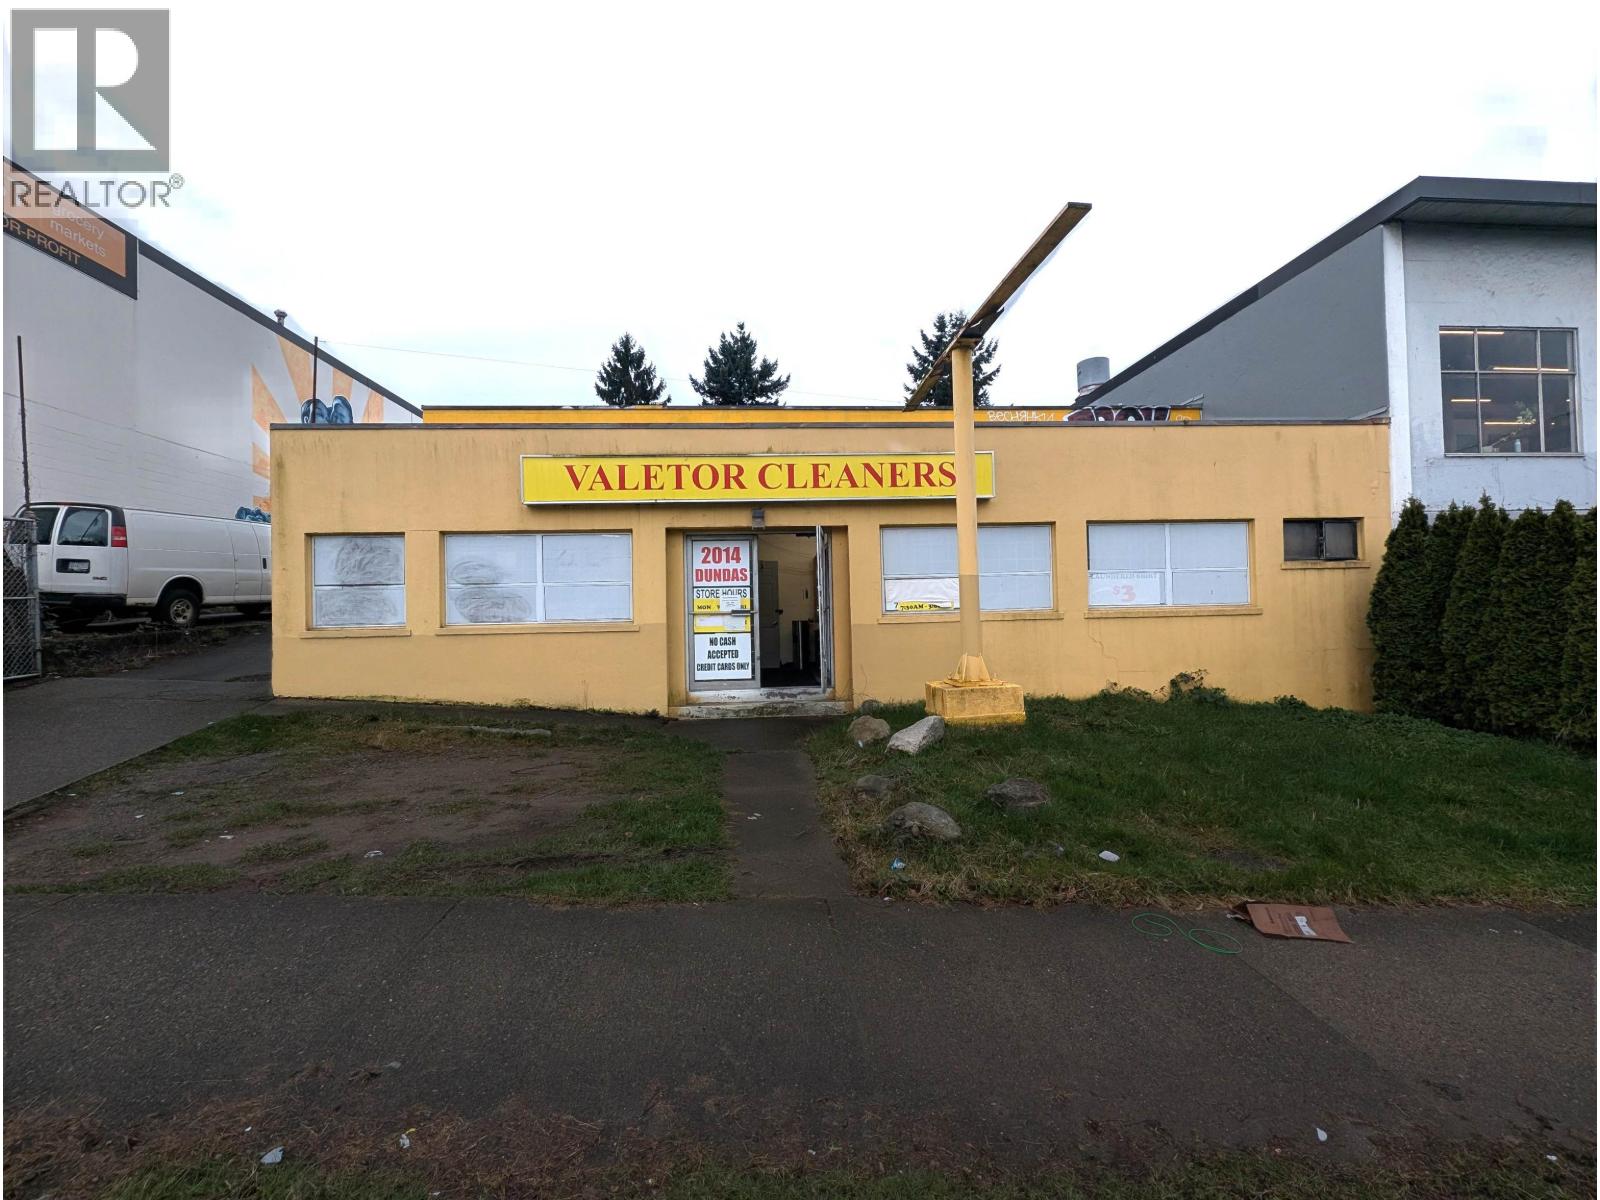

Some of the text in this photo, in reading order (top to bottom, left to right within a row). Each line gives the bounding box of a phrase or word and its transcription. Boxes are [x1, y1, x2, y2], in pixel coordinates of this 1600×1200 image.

[50, 217, 107, 258] markets
[565, 461, 957, 491] VALETOR CLEANERS
[701, 547, 741, 564] 2014
[695, 567, 748, 582] DUNDAS
[696, 588, 748, 599] STORE HOURS
[709, 636, 737, 646] NO CASH
[707, 650, 739, 660] ACCEPTED
[696, 662, 750, 672] CREDIT CARDS ONLY
